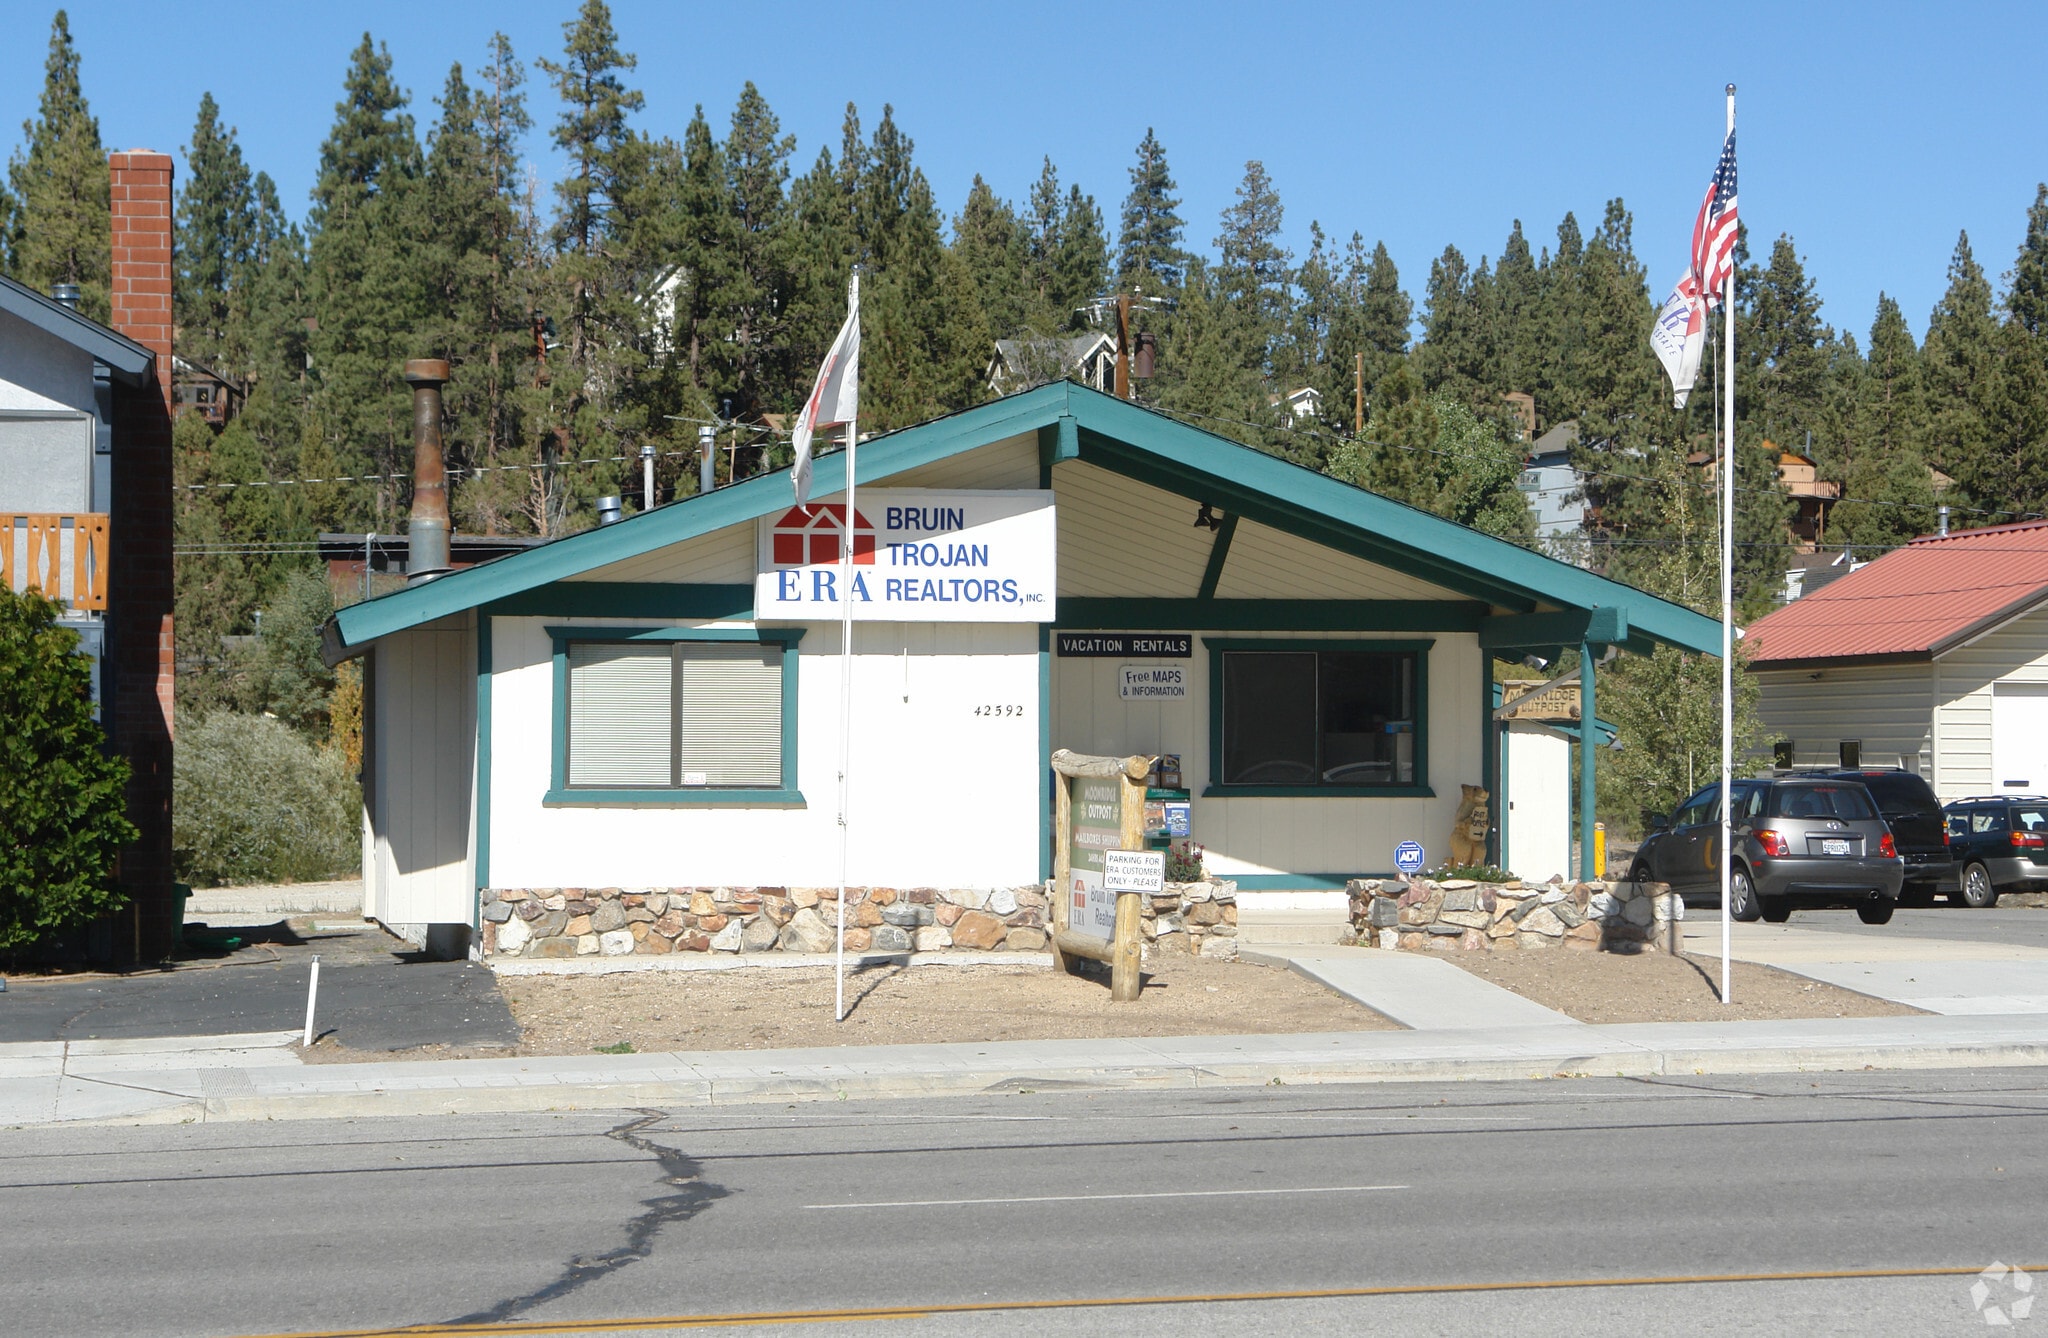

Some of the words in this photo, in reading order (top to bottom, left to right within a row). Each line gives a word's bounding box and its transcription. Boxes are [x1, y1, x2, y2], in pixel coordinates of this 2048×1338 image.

[886, 507, 964, 531] BRUIN
[886, 543, 988, 567] TROJAN
[775, 569, 874, 602] ERA
[886, 579, 1024, 606] REALTORS,
[1026, 593, 1045, 603] INC.
[1062, 639, 1123, 652] VACATION
[1133, 639, 1187, 652] RENTALS
[1125, 671, 1150, 685] Free
[1152, 670, 1182, 683] MAPS
[1122, 687, 1128, 696] &
[1131, 686, 1185, 697] INFORMATION
[974, 705, 1024, 717] 42592
[1521, 702, 1566, 713] OUTPOST
[1088, 804, 1112, 820] OUTPOST
[1074, 832, 1101, 846] MAILBOXES
[1109, 855, 1142, 865] PARKING
[1145, 857, 1160, 866] FOR
[1400, 850, 1419, 862] ADT
[1106, 865, 1119, 874] ERA
[1122, 866, 1161, 877] CUSTOMERS
[1107, 876, 1127, 885] ONLY
[1133, 877, 1159, 887] PLEASE
[1073, 909, 1085, 926] ERA
